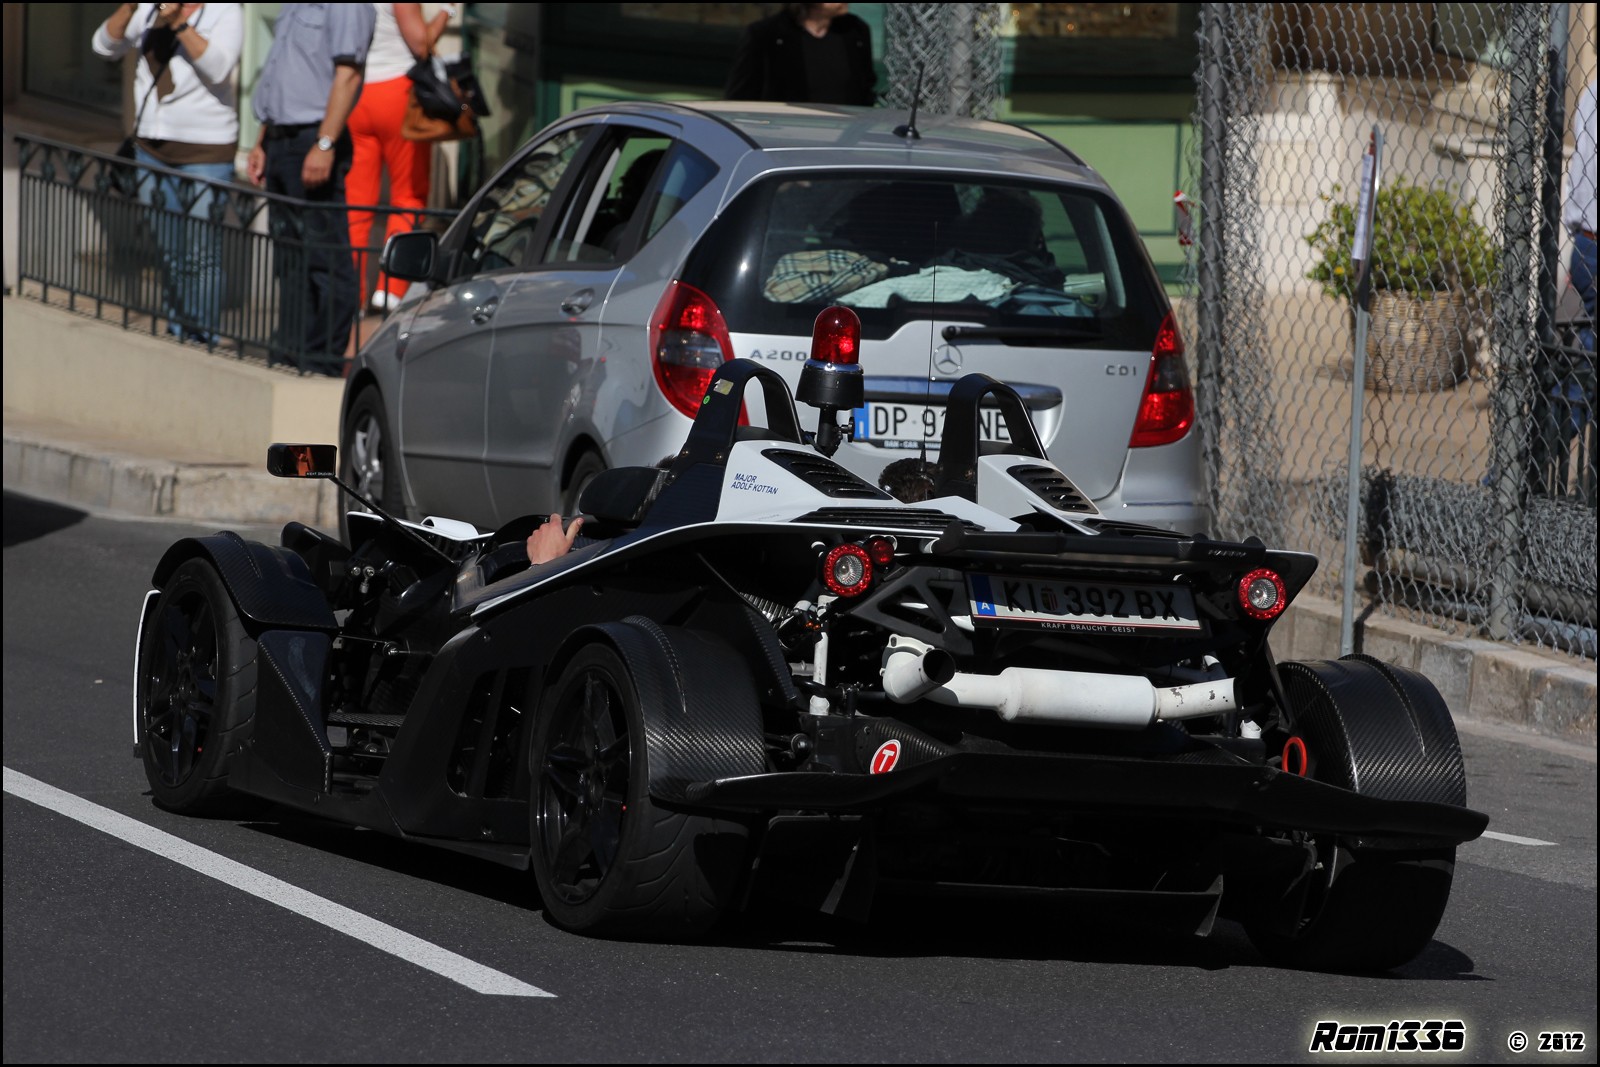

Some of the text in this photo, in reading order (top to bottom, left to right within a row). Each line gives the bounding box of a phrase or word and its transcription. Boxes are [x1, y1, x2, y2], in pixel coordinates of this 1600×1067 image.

[1105, 365, 1136, 376] CDI
[874, 406, 907, 436] DP
[734, 473, 757, 483] MAJOR
[731, 481, 779, 495] ADOLF KOTTAN
[981, 602, 990, 610] A
[1003, 581, 1181, 622] KI 392 BX
[1041, 622, 1066, 630] KRAFT
[1070, 623, 1107, 632] BRAUCHT
[882, 749, 895, 772] T
